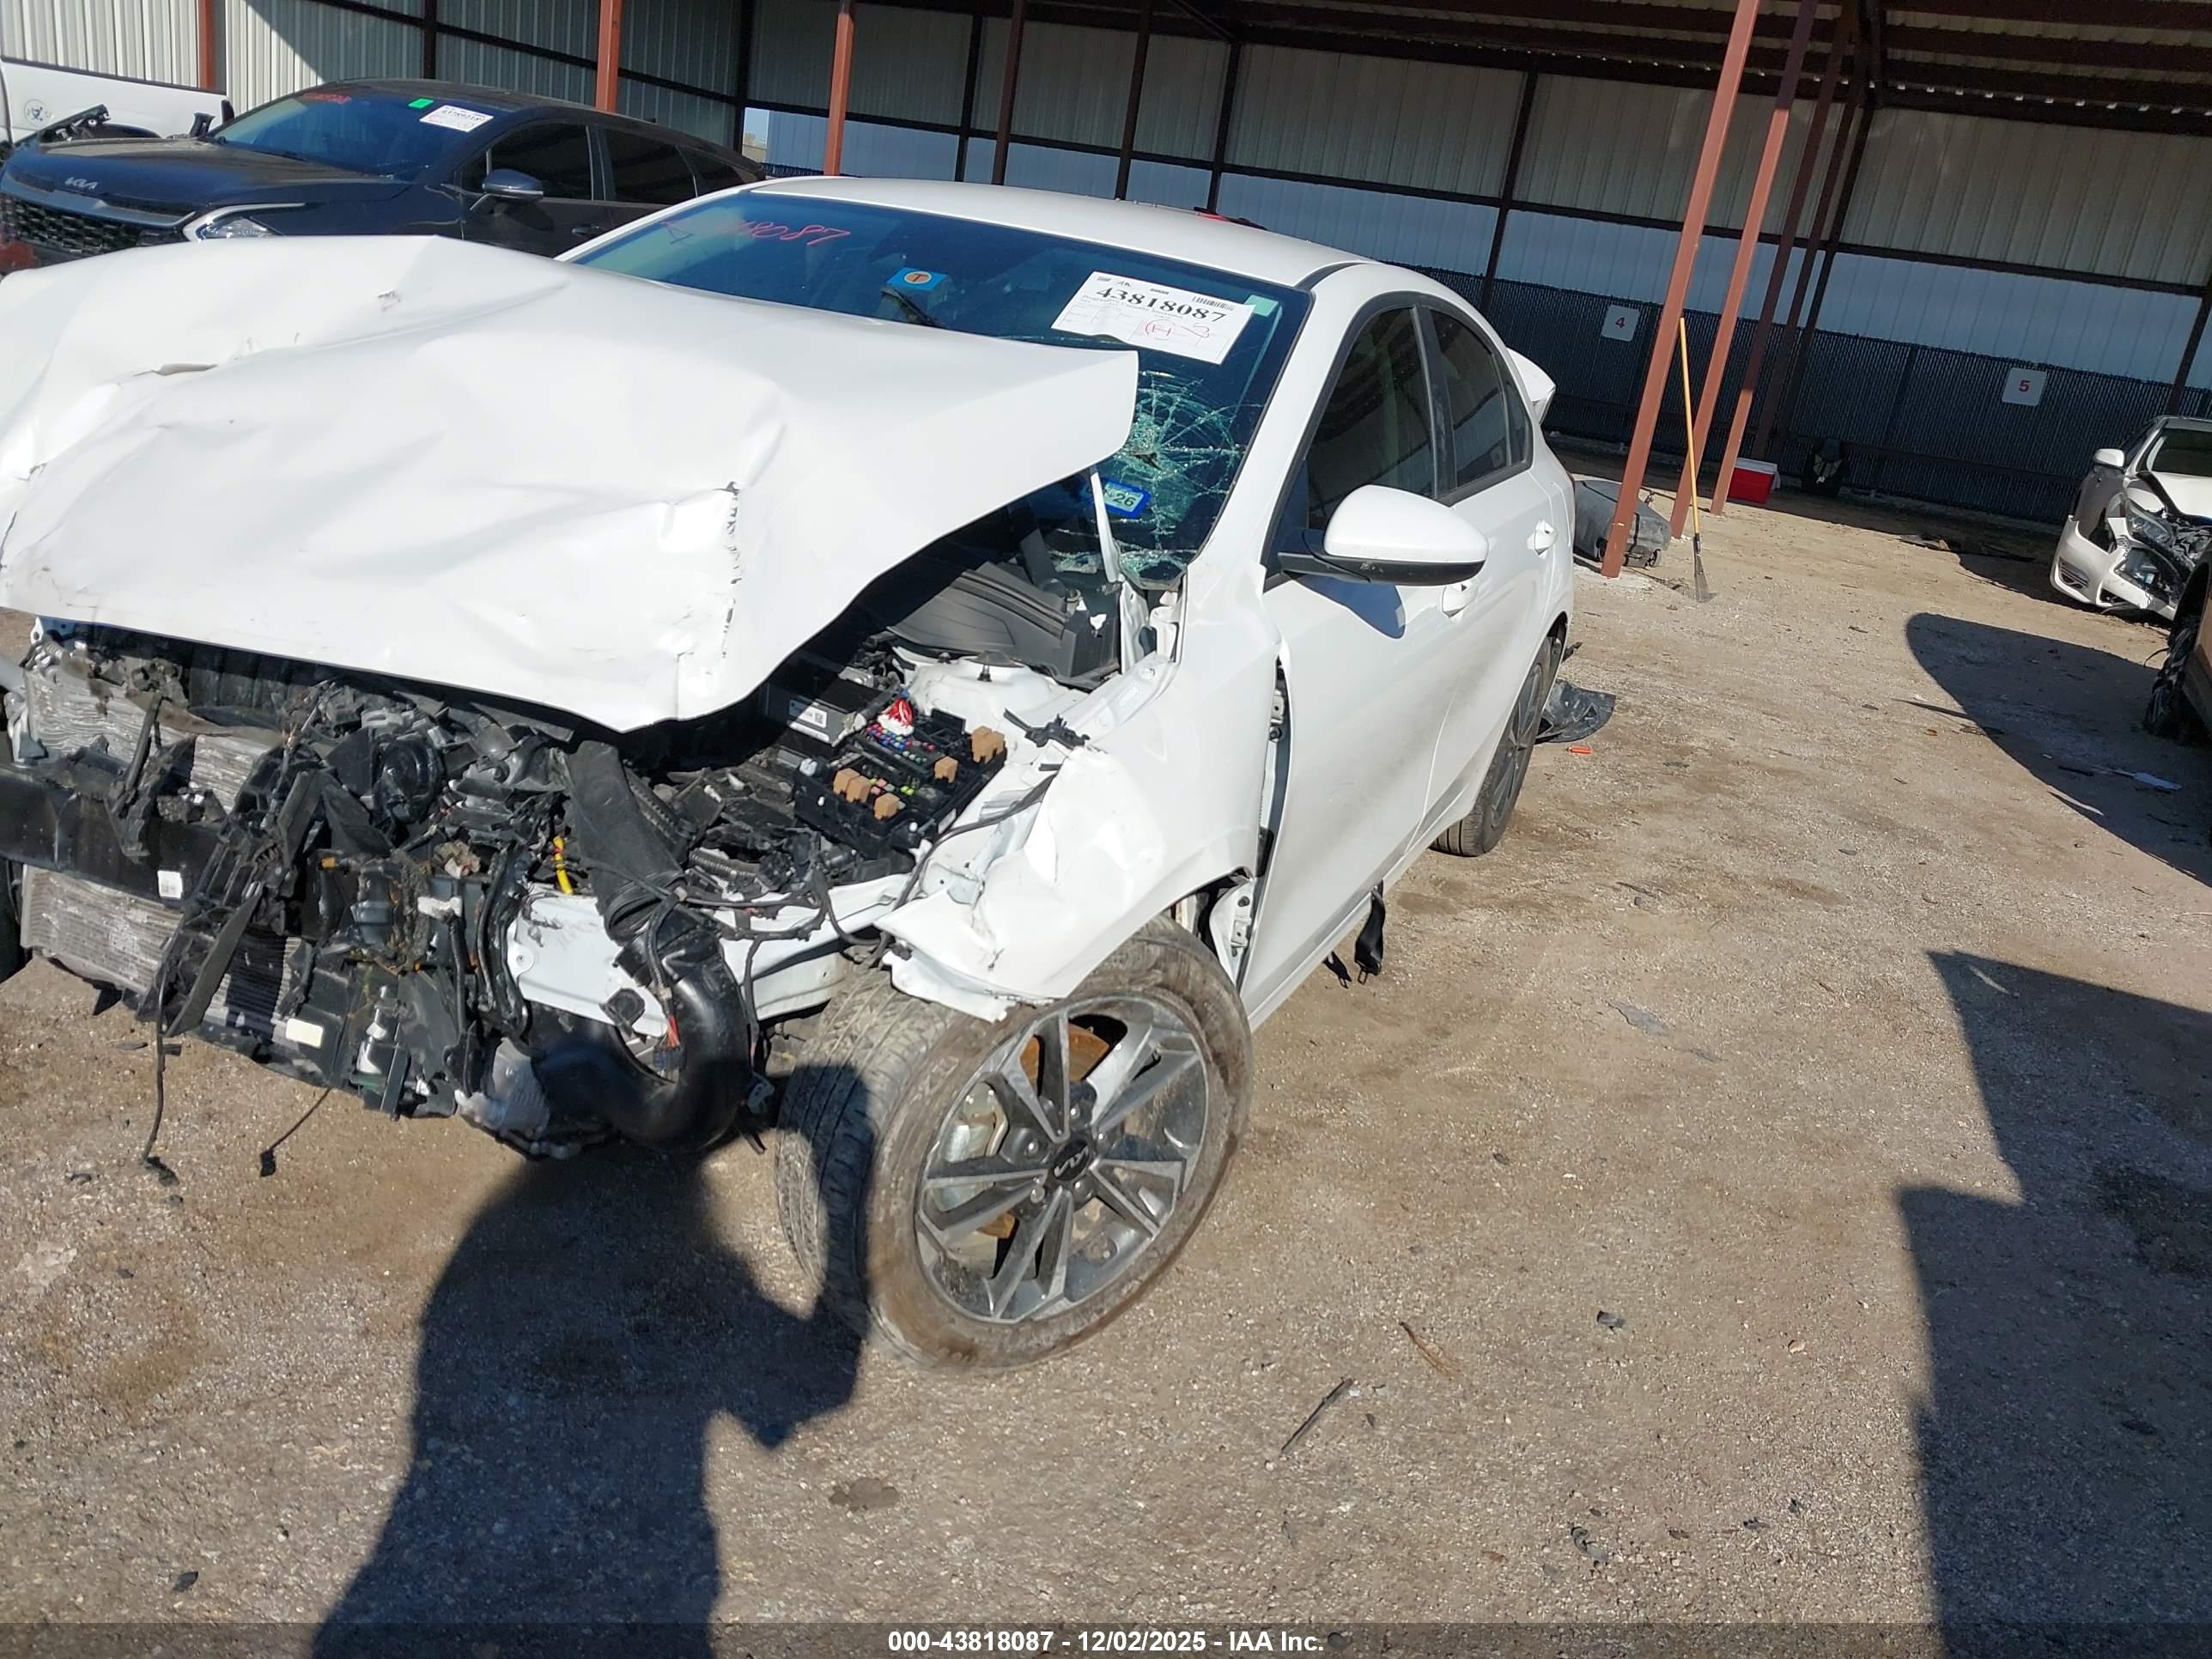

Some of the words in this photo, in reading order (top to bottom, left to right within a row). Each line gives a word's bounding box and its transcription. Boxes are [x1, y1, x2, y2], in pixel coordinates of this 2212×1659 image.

[1096, 287, 1226, 322] 43818087
[1615, 317, 1626, 328] 4
[2019, 380, 2032, 392] 5
[1113, 494, 1136, 507] 26
